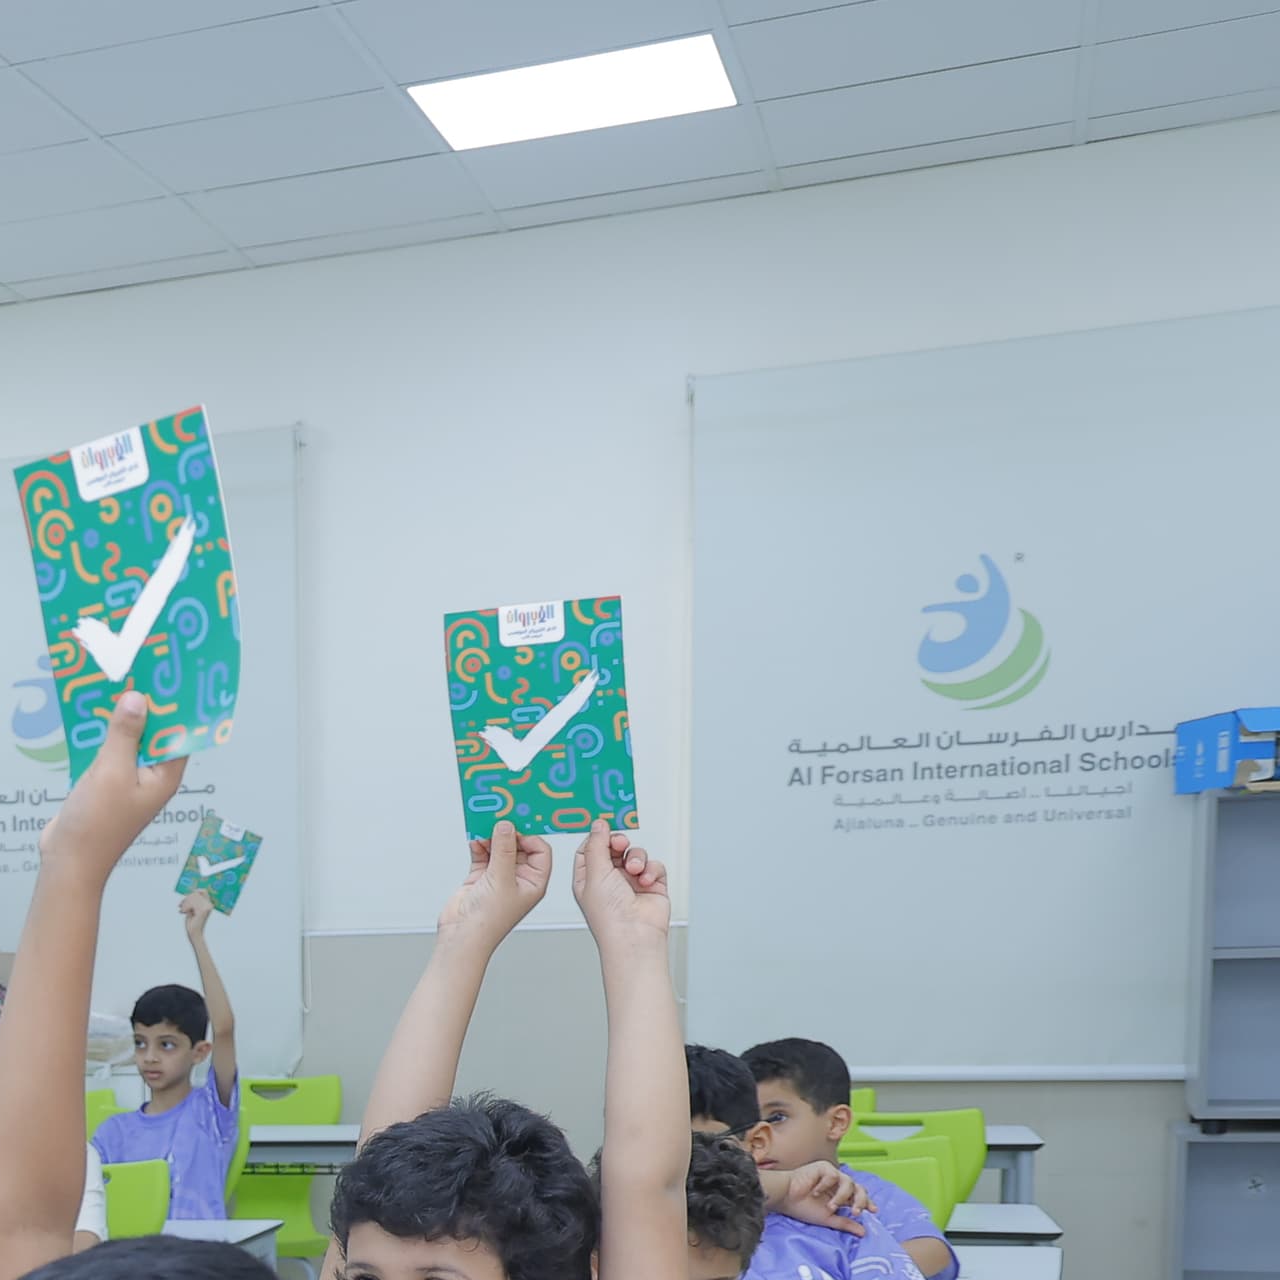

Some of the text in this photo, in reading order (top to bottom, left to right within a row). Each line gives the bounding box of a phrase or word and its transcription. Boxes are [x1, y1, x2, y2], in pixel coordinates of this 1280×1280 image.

[788, 720, 1176, 757] دارس الفرسان العالمية
[787, 766, 812, 787] Al
[820, 764, 904, 785] Forsan
[913, 753, 1070, 781] International
[1003, 810, 1037, 824] and
